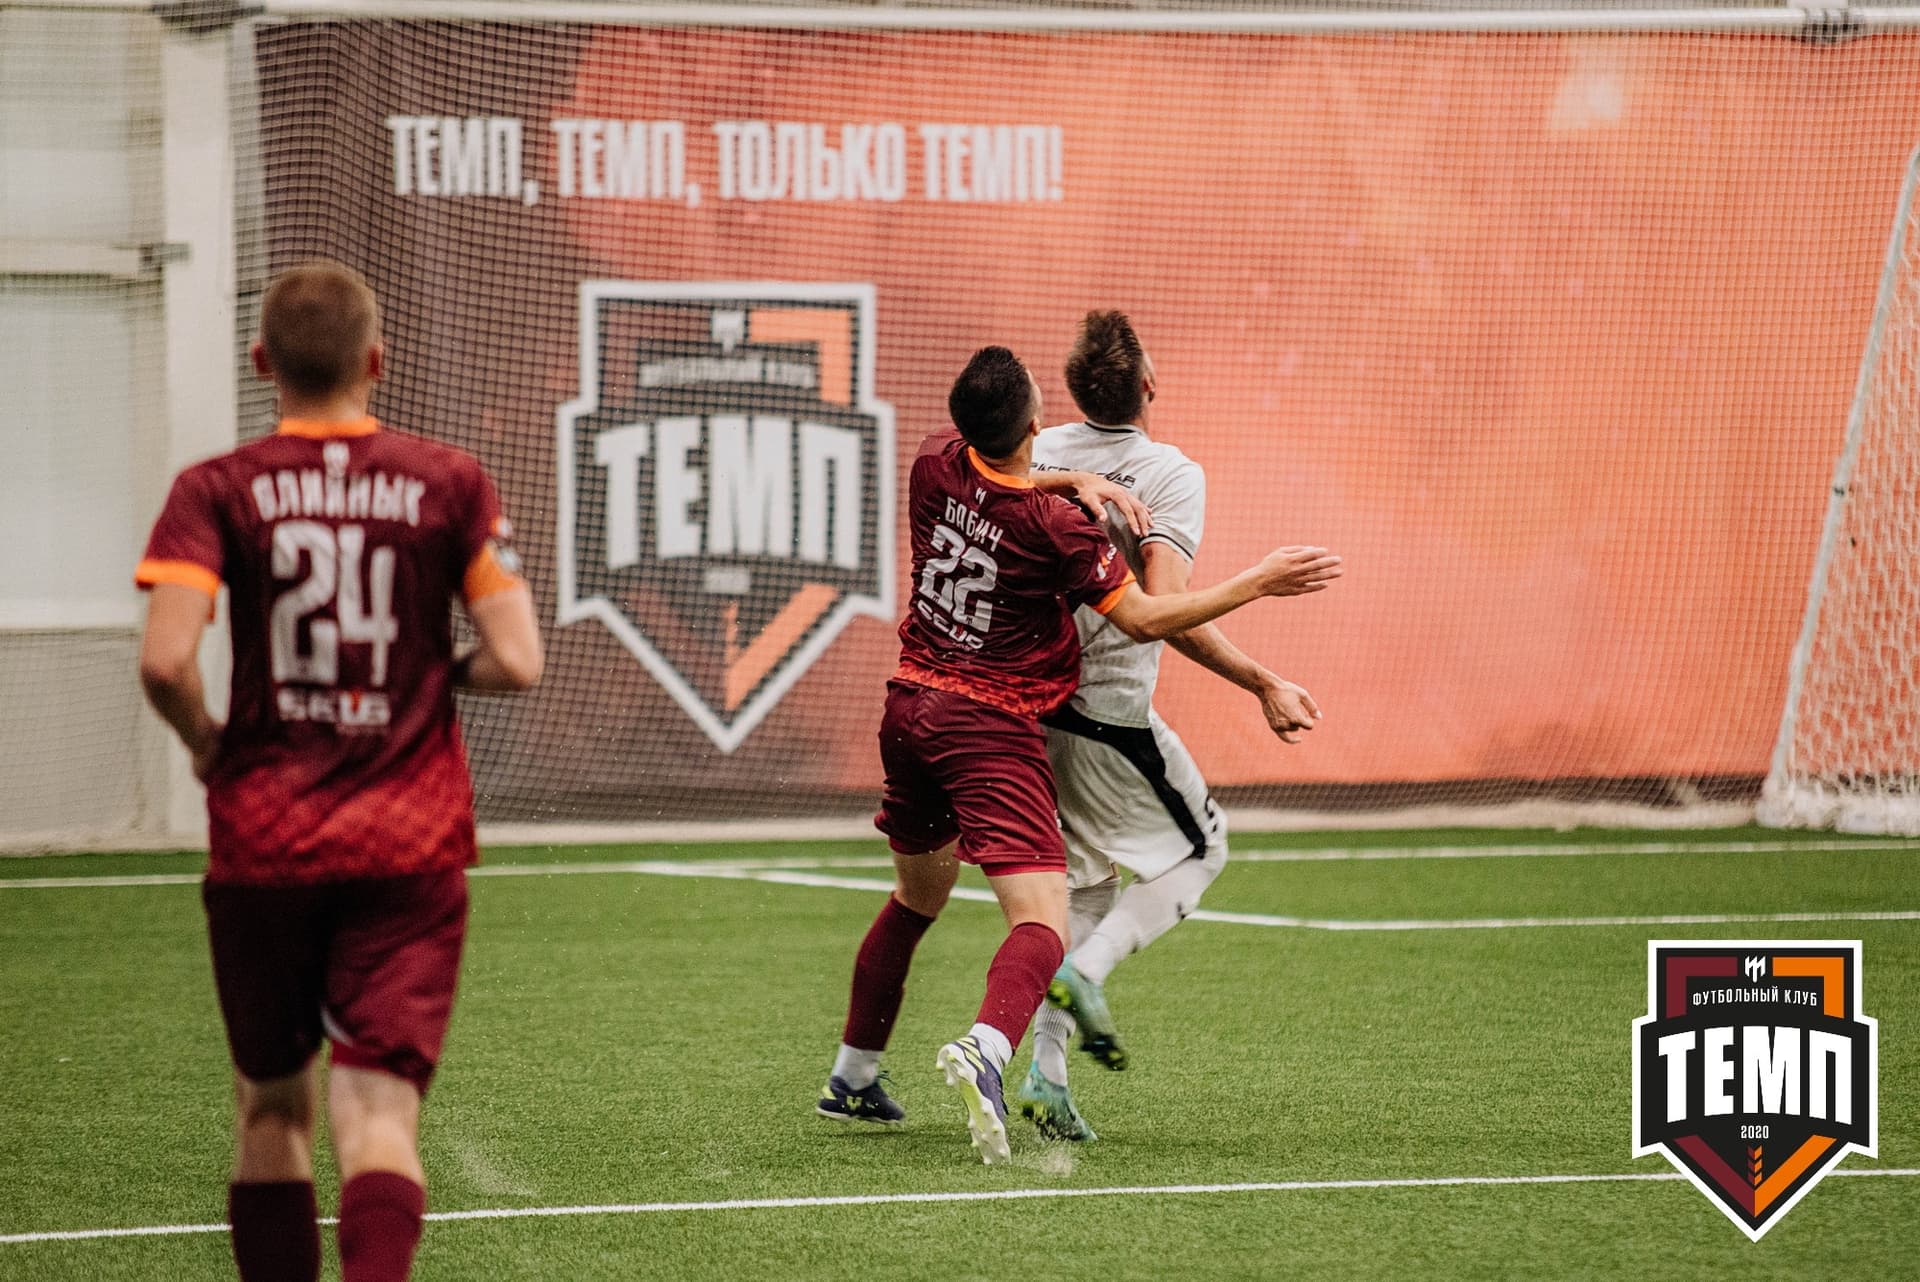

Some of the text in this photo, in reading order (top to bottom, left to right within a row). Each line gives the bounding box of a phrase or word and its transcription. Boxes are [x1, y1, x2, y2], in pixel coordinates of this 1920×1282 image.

[388, 116, 1063, 208] ТЕМП, ТЕМП, ТОЛЬКО ТЕМП!
[595, 414, 861, 570] ТЕМП
[945, 496, 1003, 552] БАБИЧ
[271, 519, 399, 687] 24
[918, 524, 998, 633] 22
